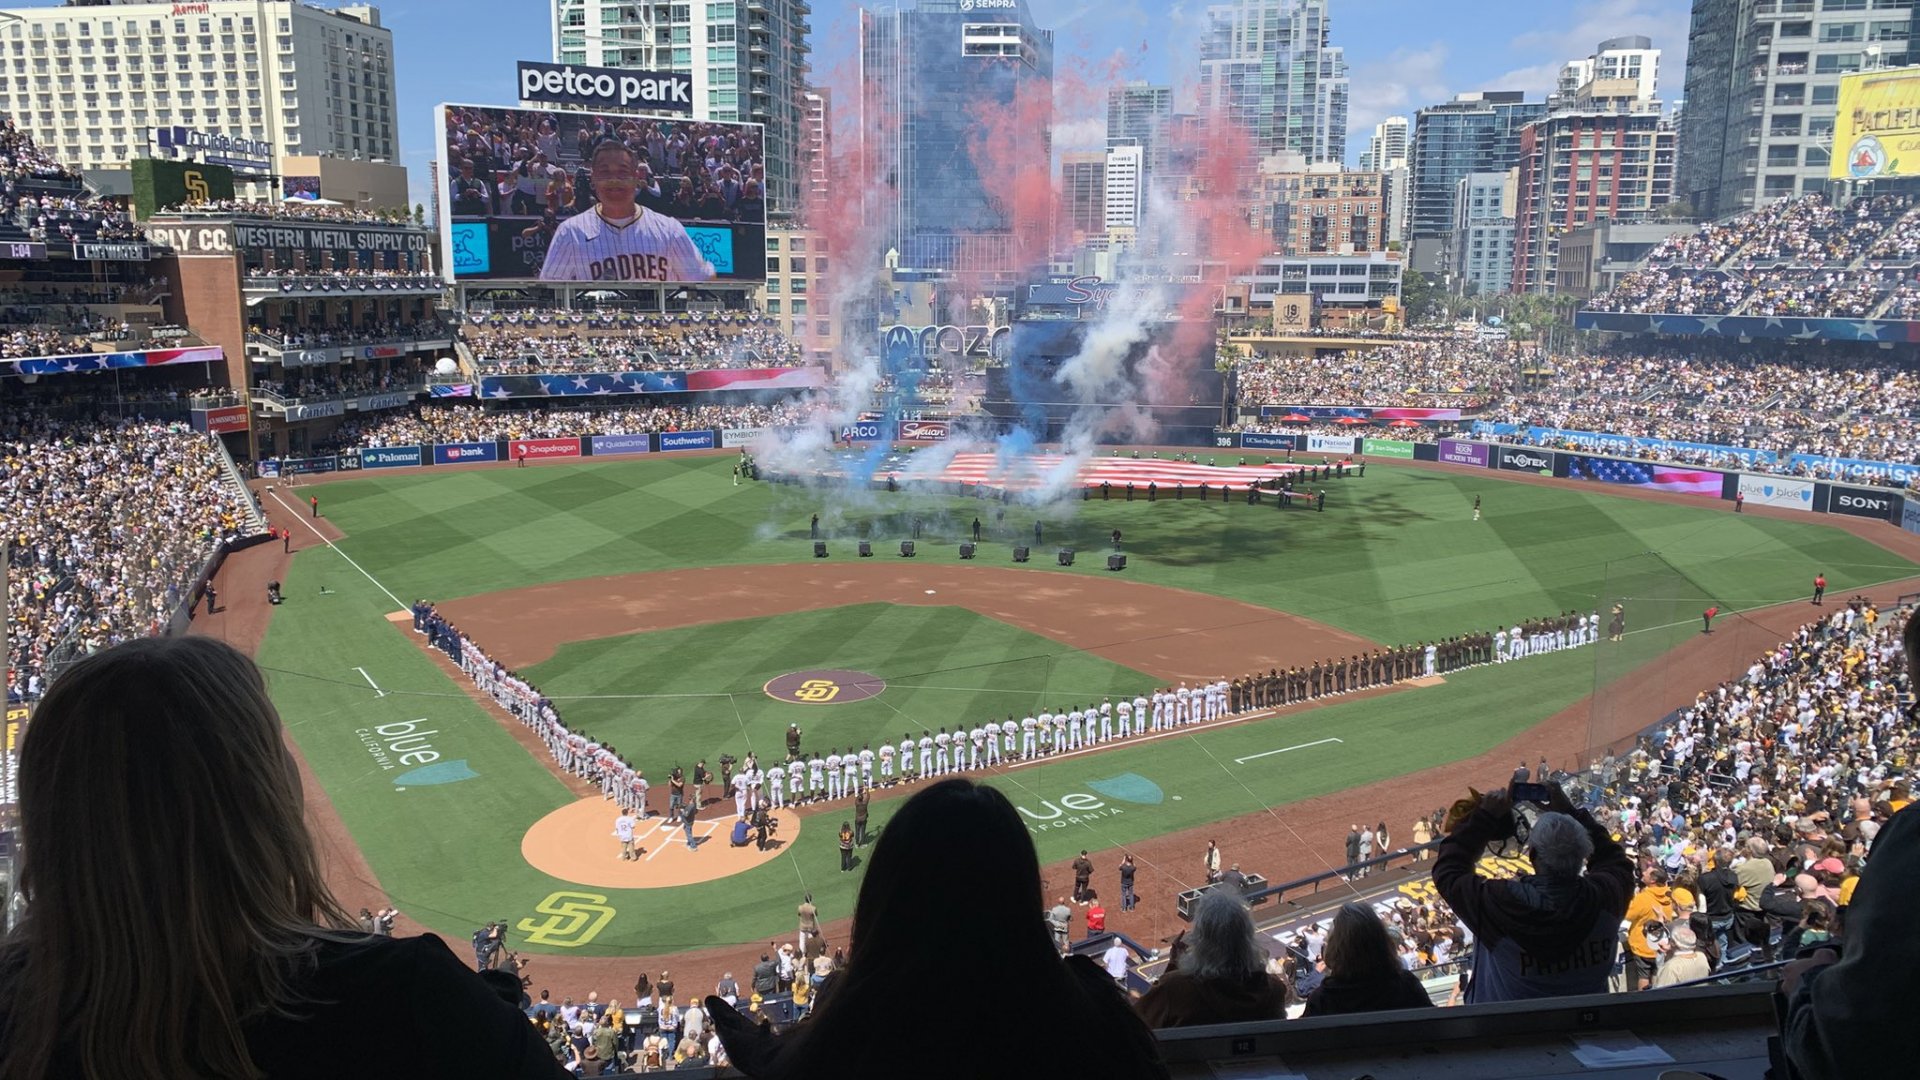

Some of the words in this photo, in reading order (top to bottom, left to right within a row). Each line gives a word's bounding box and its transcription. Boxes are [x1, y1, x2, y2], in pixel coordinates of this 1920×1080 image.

[172, 3, 210, 17] Marriott
[976, 0, 1016, 9] SEMPRA
[521, 66, 616, 98] petco
[620, 76, 690, 105] park
[1851, 107, 1920, 135] PACIFI
[198, 229, 233, 251] CO.
[234, 226, 304, 248] WESTERN
[311, 231, 354, 249] METAL
[357, 232, 402, 251] SUPPLY
[408, 235, 427, 251] CO.
[512, 233, 545, 252] pet
[10, 244, 31, 258] 1:04
[523, 250, 544, 265] pa
[589, 254, 669, 281] PADRES
[1286, 304, 1298, 316] 19
[918, 324, 1011, 358] razr
[842, 426, 878, 438] ARCO
[903, 423, 945, 439] Sycuan
[605, 440, 647, 449] QuidelOrtho
[663, 437, 704, 446] Southwest
[1217, 437, 1232, 447] 396
[448, 449, 459, 458] us
[460, 446, 484, 457] bank
[530, 444, 577, 455] Snapdragon
[340, 457, 358, 469] 342
[378, 452, 419, 463] Palomar
[1445, 454, 1466, 462] NEXEN
[1467, 456, 1482, 464] TIRE
[1504, 454, 1547, 468] EVOTEK
[1740, 483, 1763, 494] blue
[1776, 487, 1800, 498] blue
[374, 718, 440, 766] blue
[355, 728, 395, 771] CALIFORNIA
[1017, 793, 1105, 820] ue
[1027, 807, 1124, 834] IFORNIA
